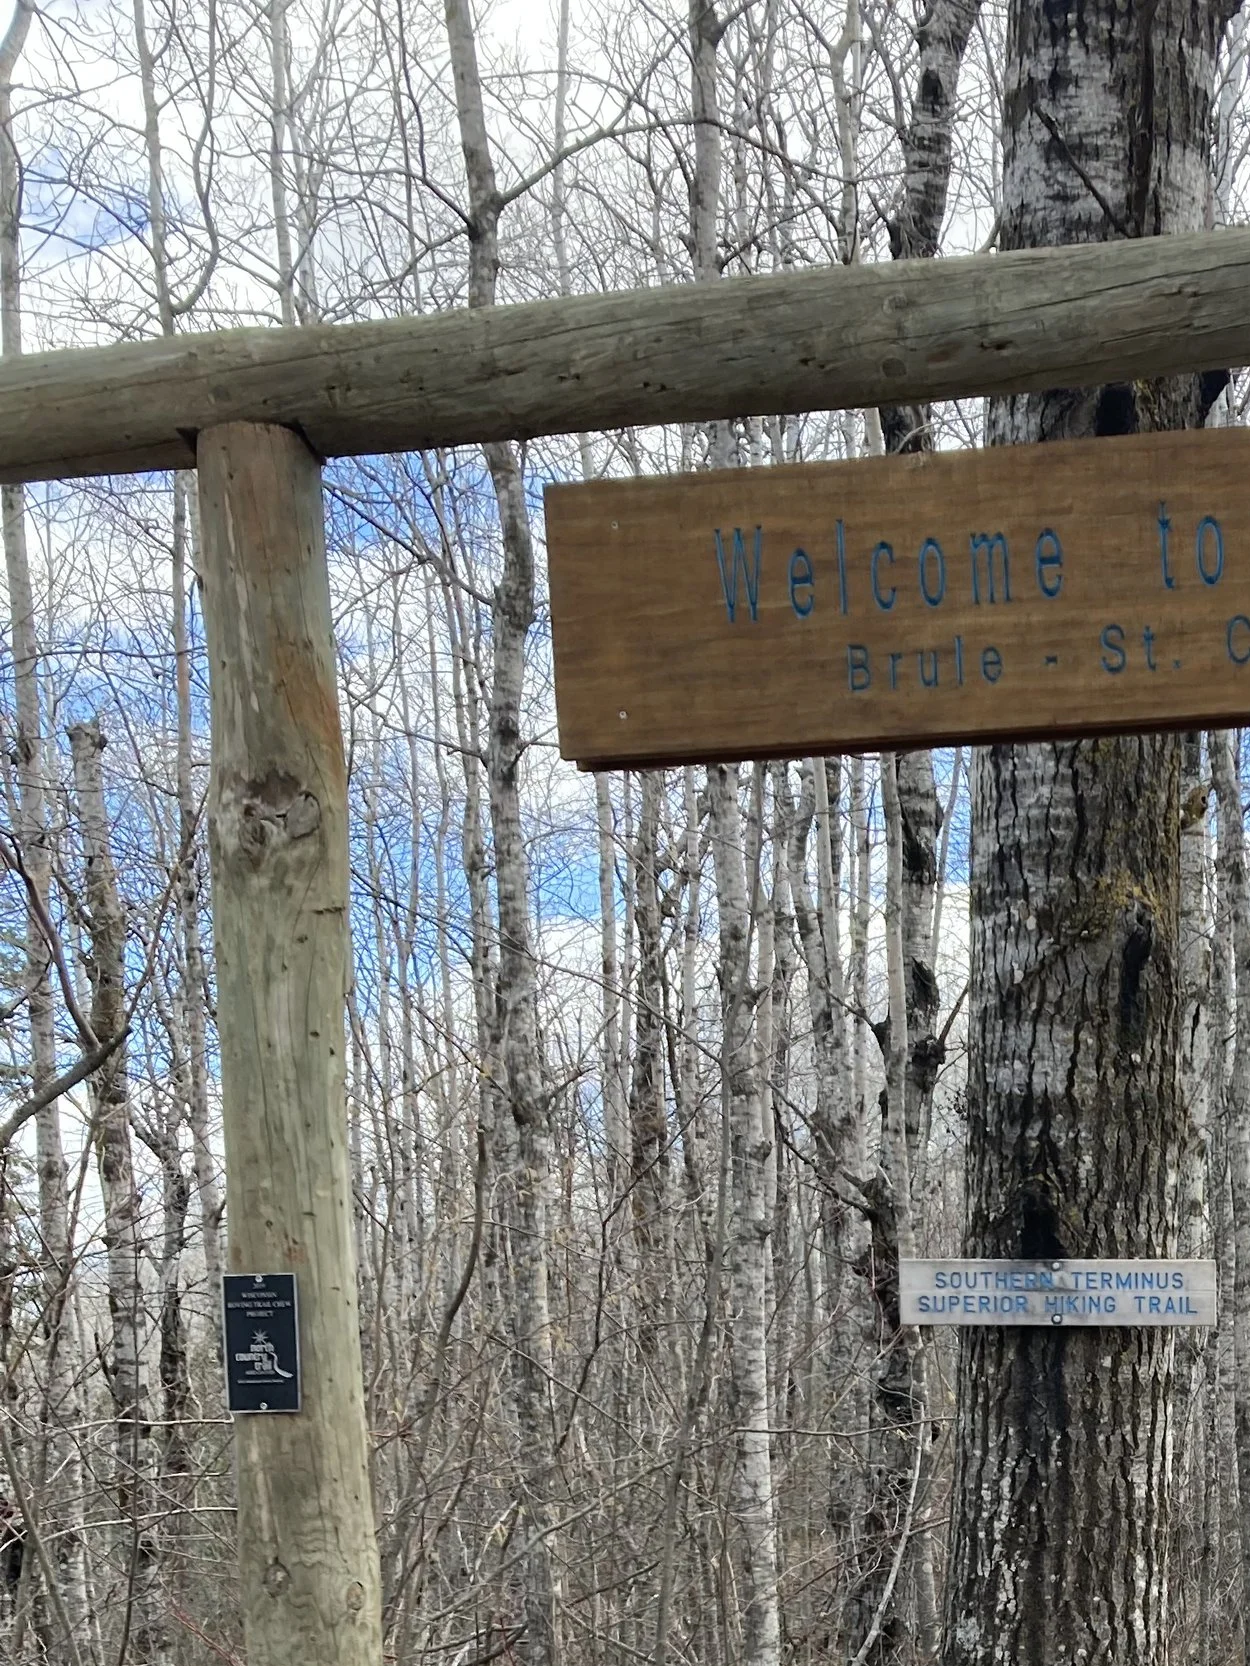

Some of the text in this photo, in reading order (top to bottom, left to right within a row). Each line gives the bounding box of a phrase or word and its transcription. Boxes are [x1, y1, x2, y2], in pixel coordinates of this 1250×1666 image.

[713, 519, 1064, 623] Welcome
[1158, 501, 1225, 590] to
[847, 635, 1003, 692] Brule
[1101, 623, 1182, 675] St.
[935, 1271, 1184, 1290] SOUTHERN TERMINUS
[918, 1295, 1198, 1315] SUPERIOR HIKING TRAIL
